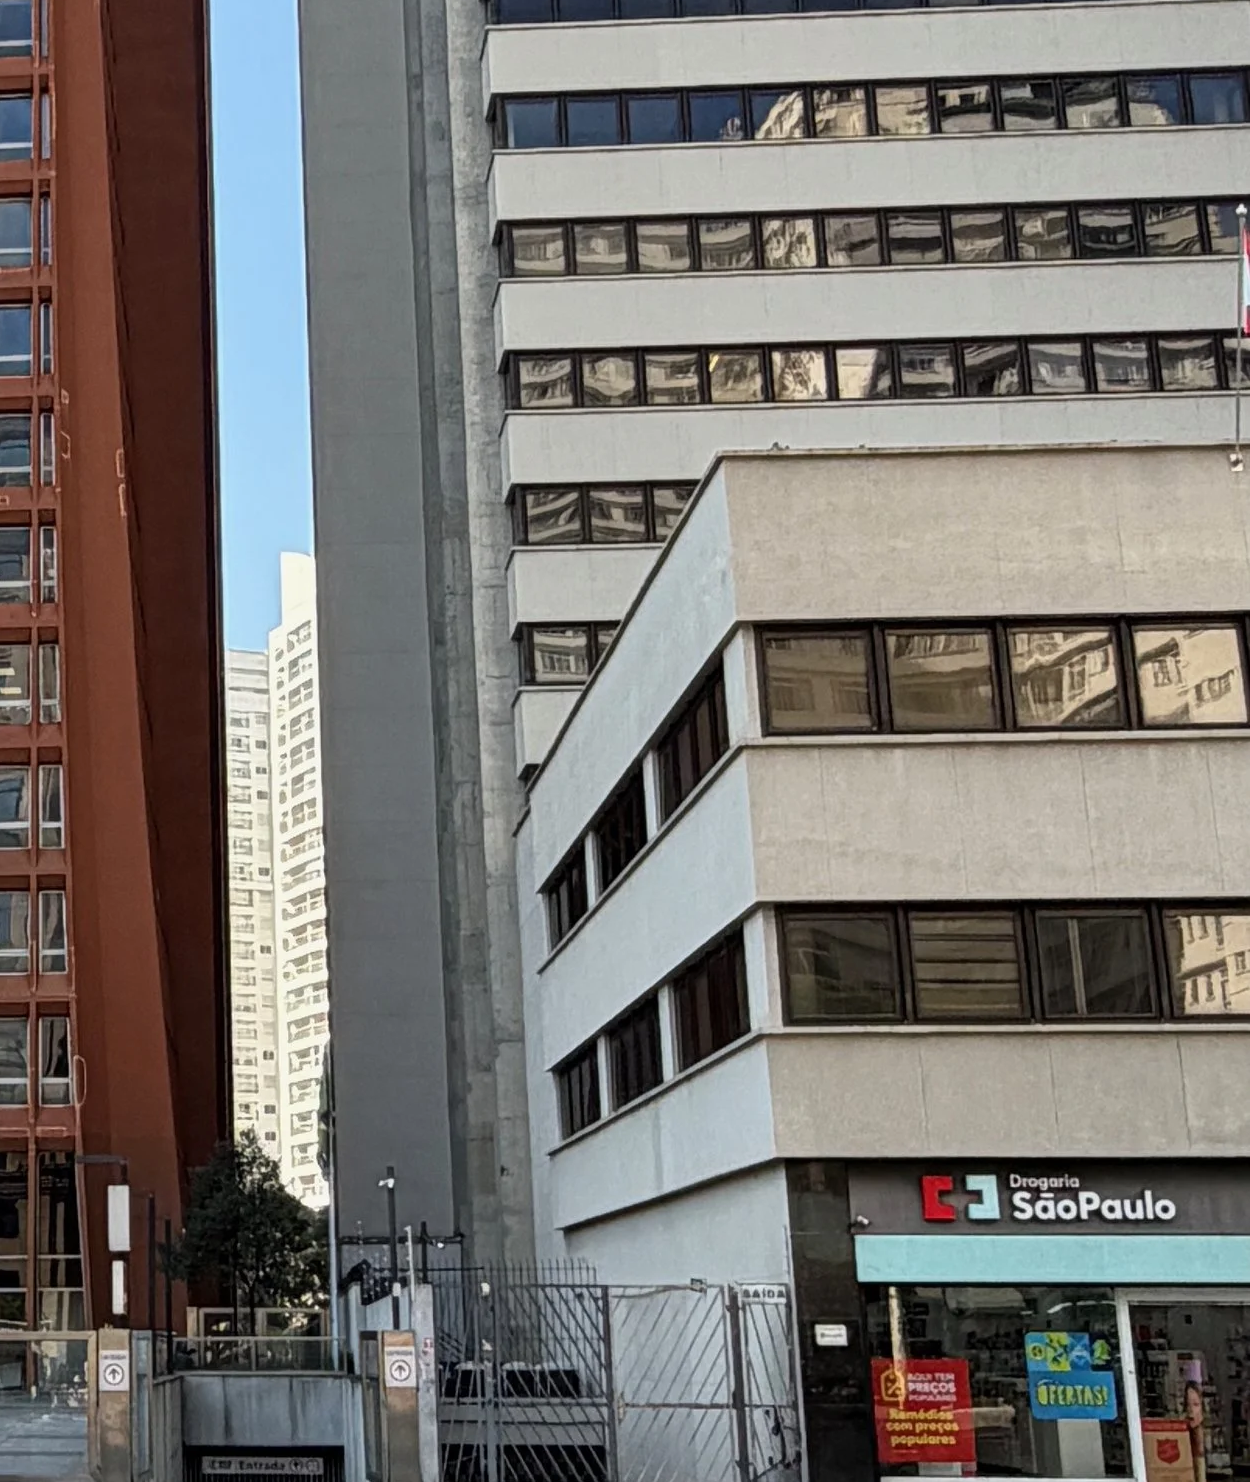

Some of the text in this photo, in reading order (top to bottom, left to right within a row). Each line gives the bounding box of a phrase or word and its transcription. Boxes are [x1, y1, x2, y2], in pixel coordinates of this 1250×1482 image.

[1009, 1173, 1080, 1190] Drogaria
[907, 1382, 956, 1394] PREÇOS
[1036, 1385, 1109, 1406] OFERTAS!
[889, 1408, 954, 1420] Remédios
[885, 1422, 959, 1434] com preços
[890, 1433, 957, 1447] populares
